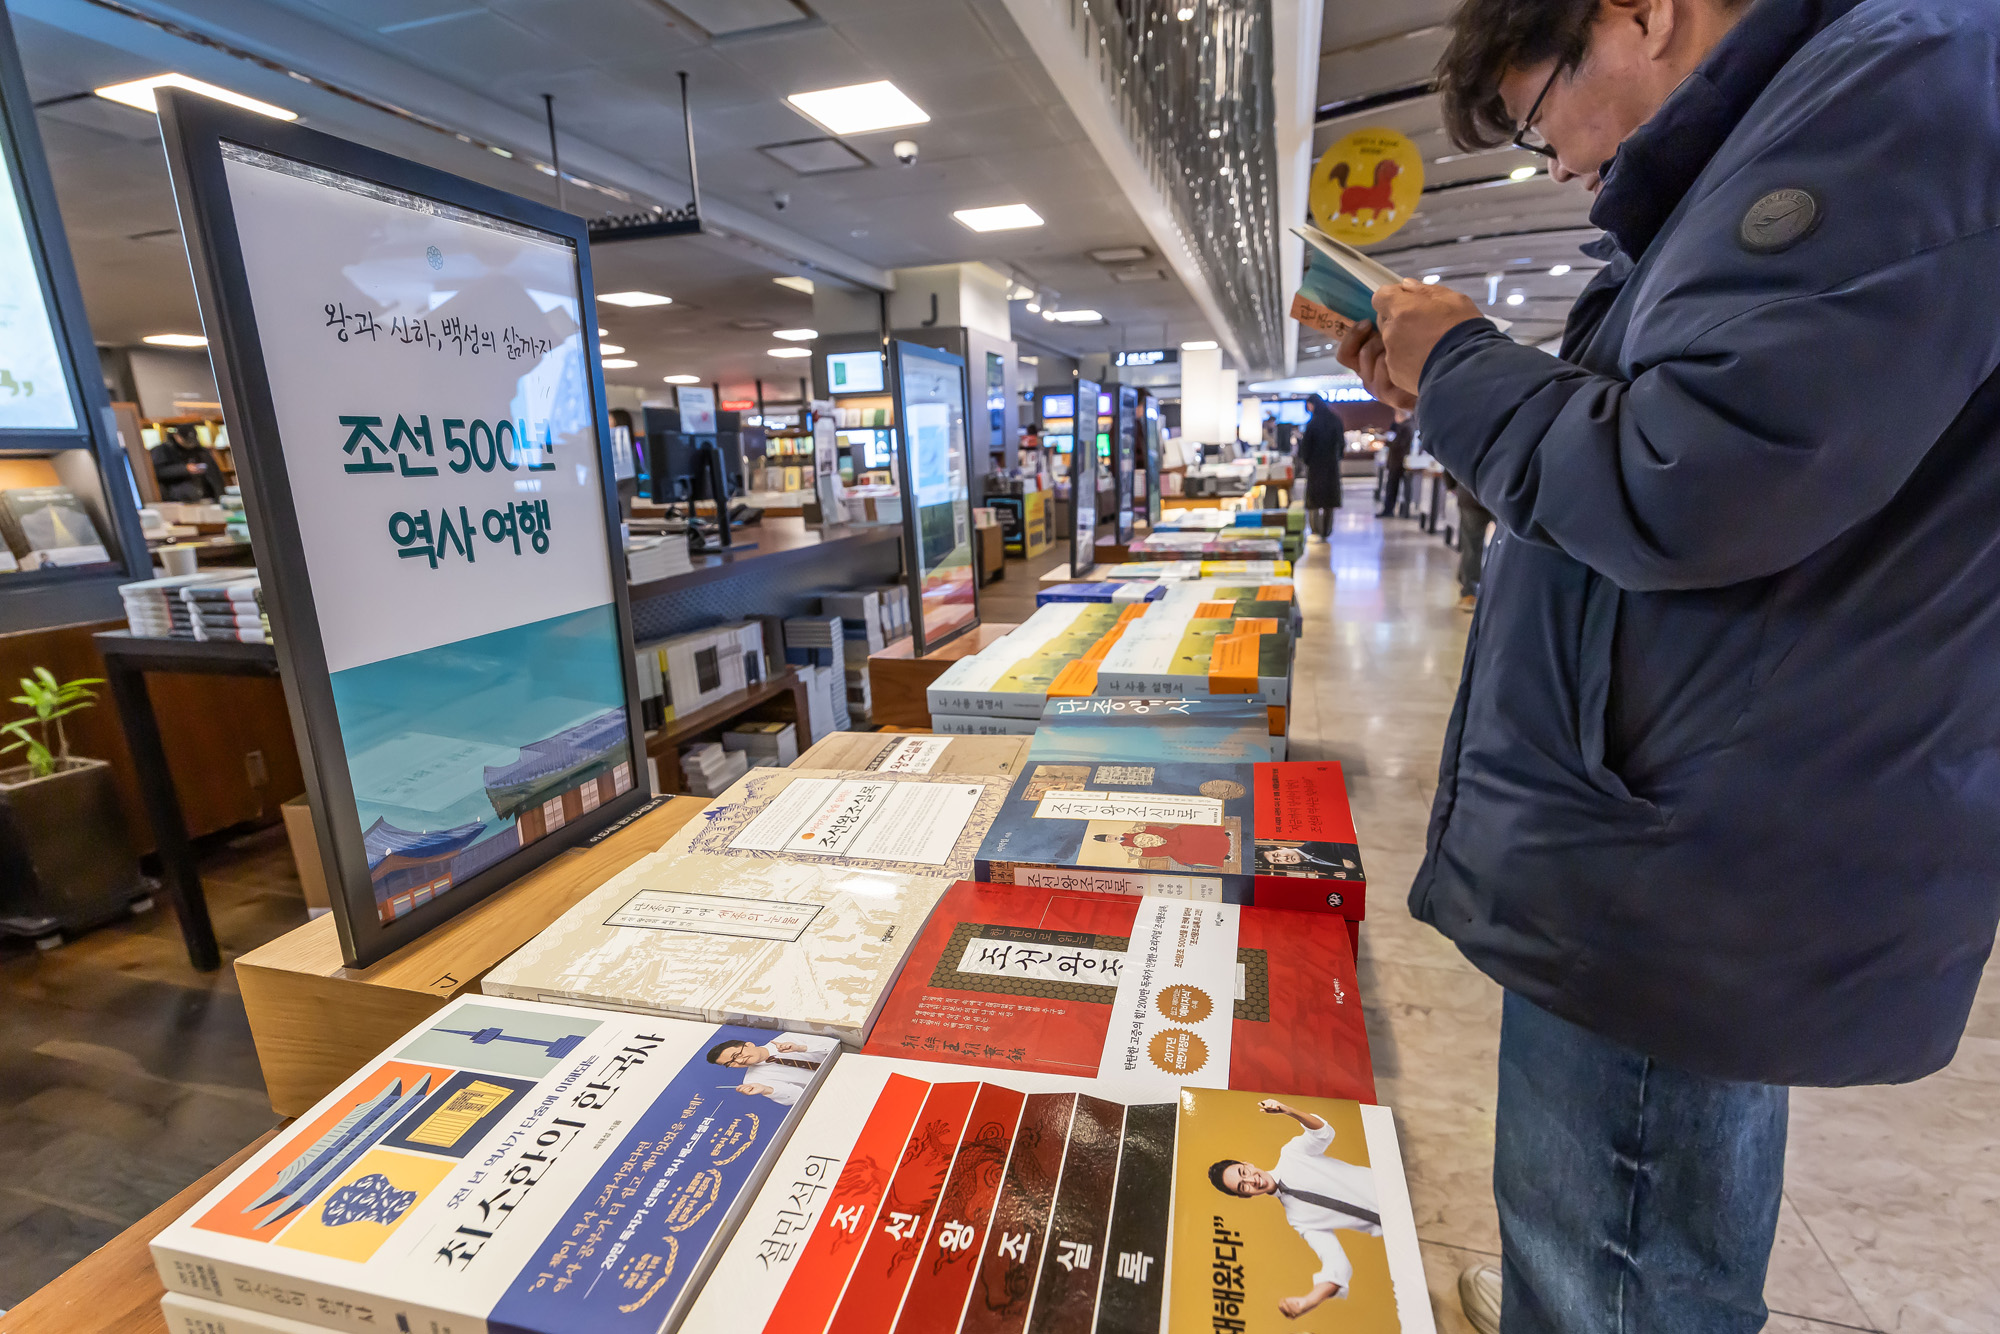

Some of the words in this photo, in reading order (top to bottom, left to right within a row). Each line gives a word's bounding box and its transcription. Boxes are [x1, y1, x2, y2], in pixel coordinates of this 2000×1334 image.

[324, 301, 383, 344] 왕과
[503, 326, 553, 360] 삶까지
[338, 412, 439, 477] 조선
[443, 417, 557, 474] 500년
[388, 504, 477, 569] 역사
[481, 499, 552, 555] 여행
[1110, 681, 1120, 692] 나
[1125, 681, 1147, 693] 사용
[1152, 681, 1184, 693] 설명서
[939, 698, 949, 708] 나
[953, 698, 971, 709] 사용
[976, 698, 1003, 710] 설명서
[818, 784, 882, 849] 조선왕조실록
[1051, 802, 1205, 820] 조선왕조실록
[1027, 873, 1133, 894] 조선왕조실록
[634, 901, 681, 914] 단종의
[717, 909, 764, 922] 세종의
[764, 914, 799, 925] 눈물
[990, 927, 1006, 937] 한
[1009, 929, 1051, 942] 권으로
[1057, 933, 1088, 945] 읽는
[1150, 930, 1163, 953] 오리지널
[1177, 928, 1189, 948] 500년을
[1145, 952, 1158, 970] 인정한
[1174, 948, 1185, 969] 조선왕조
[1140, 969, 1154, 989] 독자가
[1137, 989, 1151, 1009] 200만
[1134, 1008, 1147, 1019] 힘!
[1129, 1021, 1145, 1046] 고증의
[1124, 1043, 1140, 1071] 탄탄한
[1163, 1037, 1177, 1063] 2017년
[1175, 1033, 1190, 1070] 전면개정판
[446, 1187, 474, 1210] 5천
[467, 1170, 488, 1185] 년
[483, 1129, 525, 1167] 역사가
[519, 1094, 560, 1130] 단숨에
[554, 1054, 600, 1093] 이해되는
[433, 1117, 588, 1273] 최소한의
[571, 1032, 666, 1111] 한국사
[549, 1240, 578, 1269] 책이
[572, 1209, 600, 1238] 역사
[595, 1141, 653, 1208] 교과서였다면
[601, 1242, 627, 1270] 20만
[619, 1209, 650, 1242] 독자가
[643, 1178, 671, 1209] 선택한
[664, 1157, 685, 1178] 역사
[678, 1116, 715, 1160] 베스트셀러
[553, 1262, 582, 1293] 역사
[576, 1219, 614, 1258] 공부가
[608, 1202, 626, 1217] 더
[621, 1175, 646, 1200] 쉽고
[641, 1120, 687, 1173] 재미있었을
[755, 1154, 841, 1271] 설민석의
